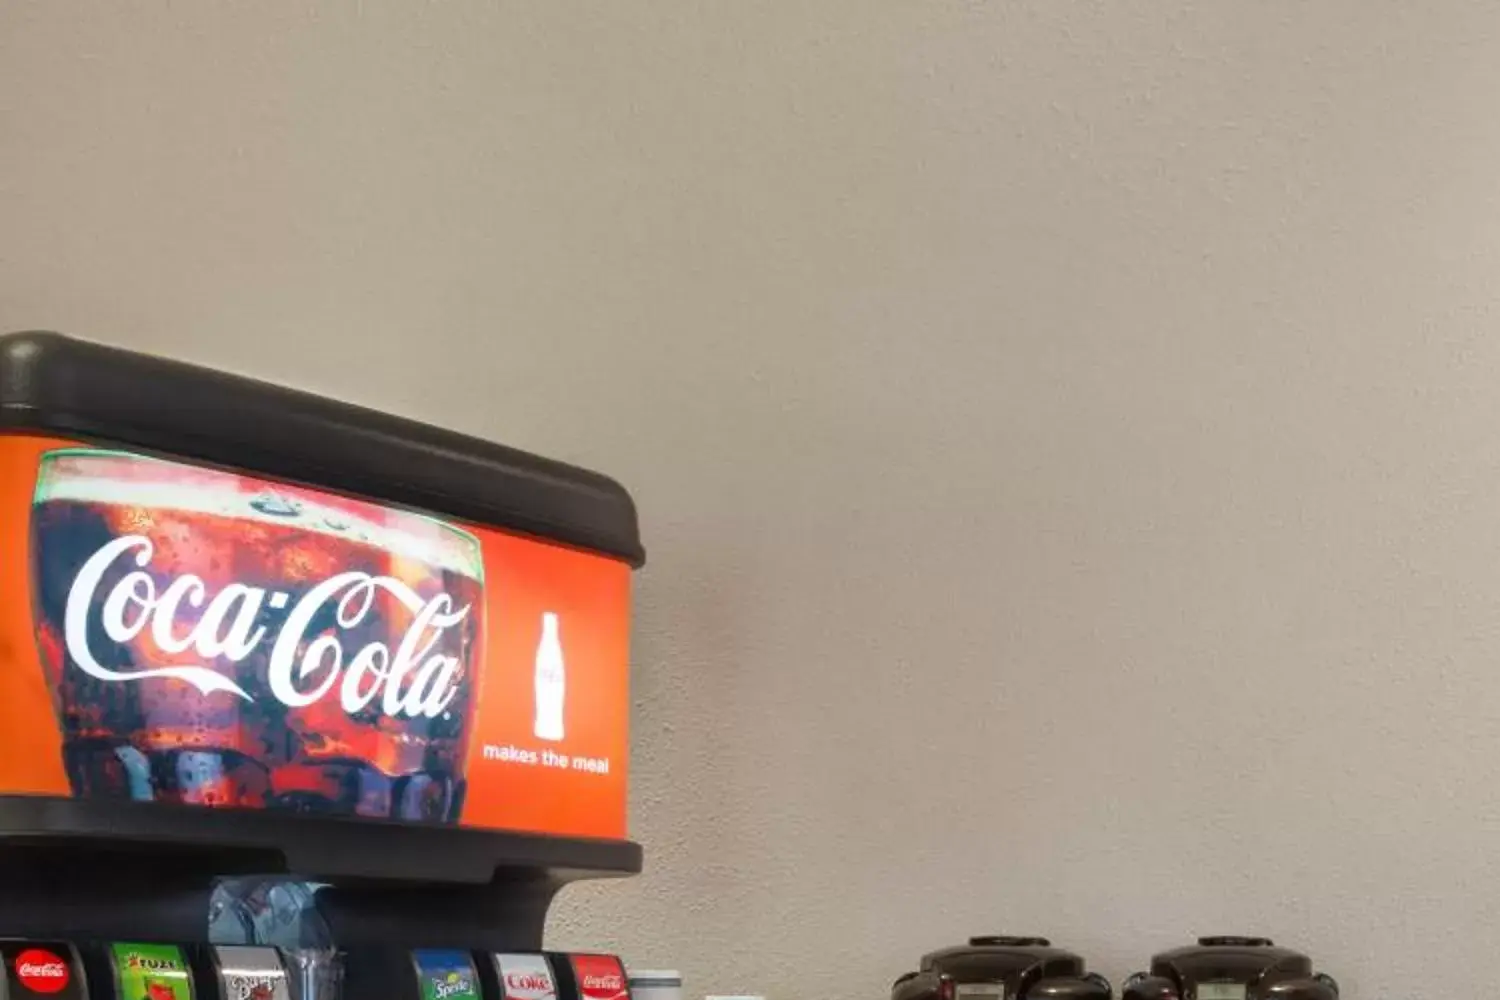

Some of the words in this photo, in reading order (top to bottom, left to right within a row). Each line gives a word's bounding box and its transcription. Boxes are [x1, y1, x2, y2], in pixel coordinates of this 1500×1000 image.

[64, 534, 471, 721] Coca-Cola
[483, 742, 537, 764] makes
[541, 748, 569, 768] the
[572, 753, 610, 774] meal
